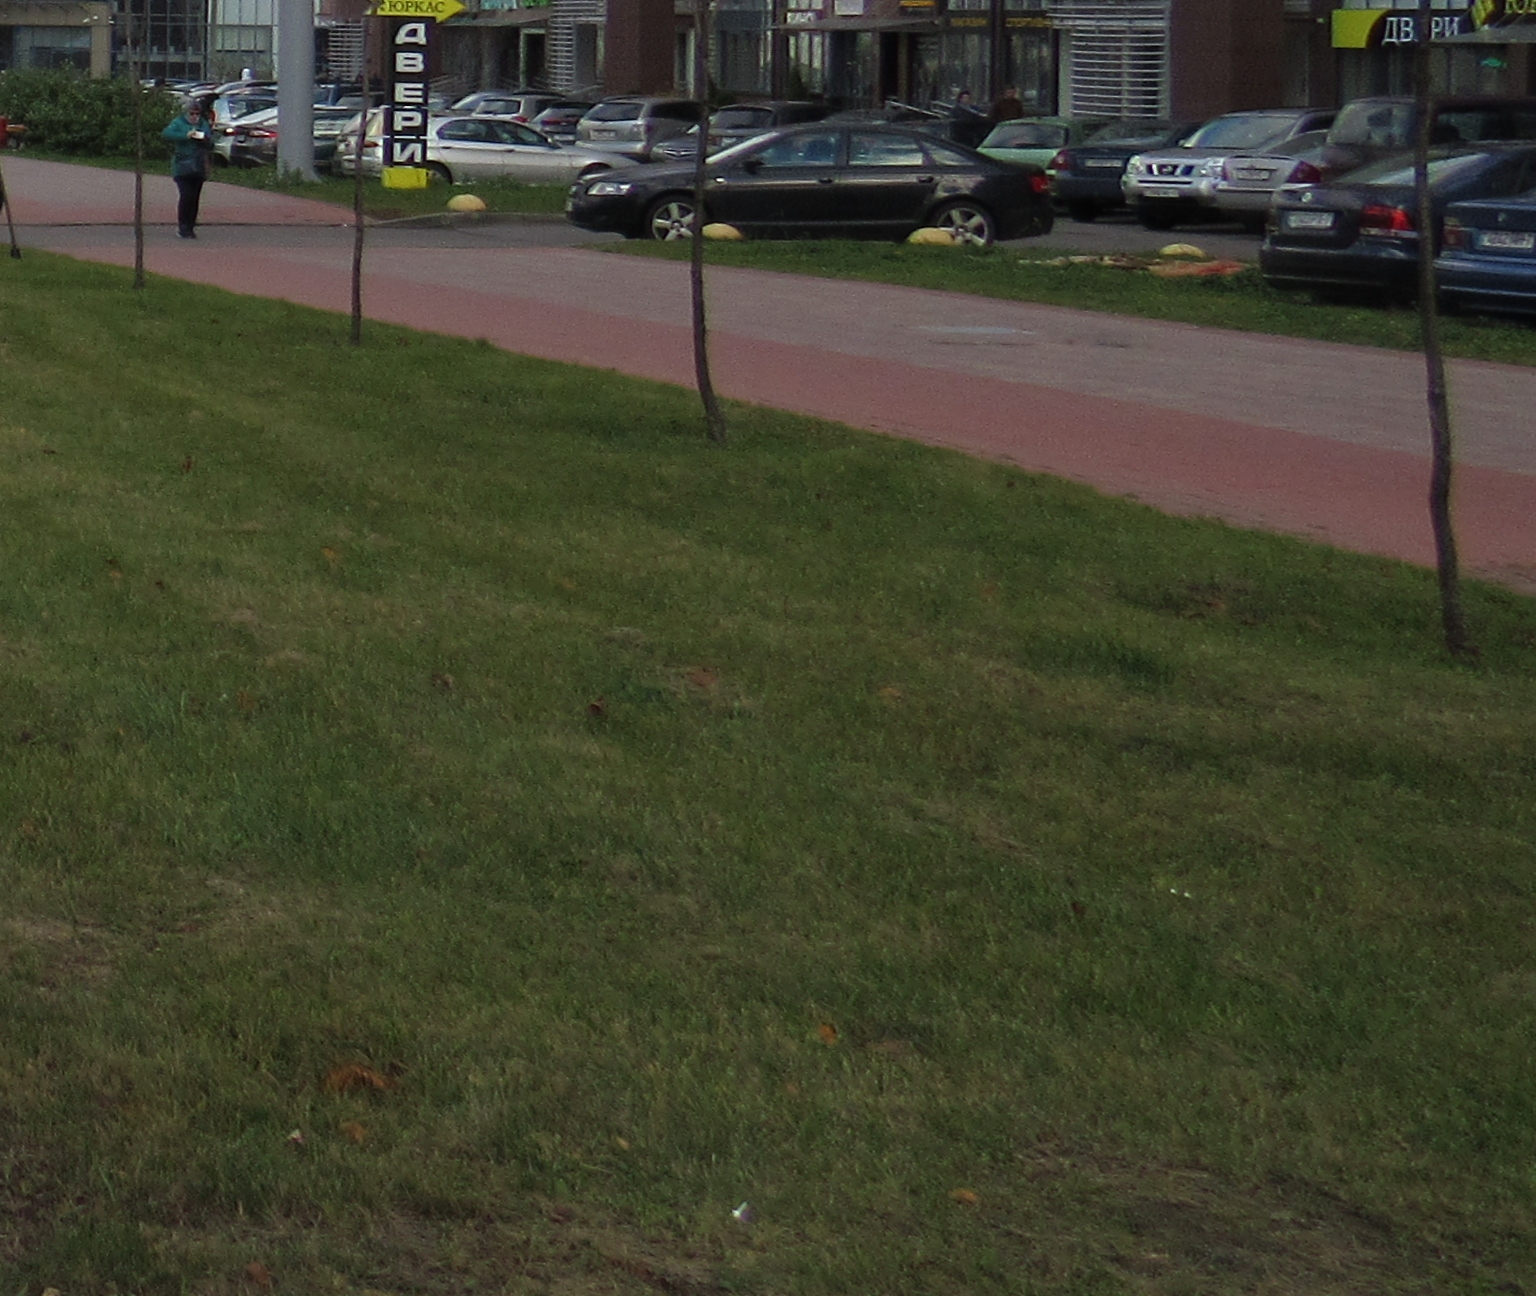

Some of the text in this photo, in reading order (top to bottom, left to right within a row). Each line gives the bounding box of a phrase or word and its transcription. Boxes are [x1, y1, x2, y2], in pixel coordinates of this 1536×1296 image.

[388, 0, 446, 13] ЮРКАС
[1381, 16, 1460, 46] ДВРИ
[393, 22, 428, 163] ДВЕРИ
